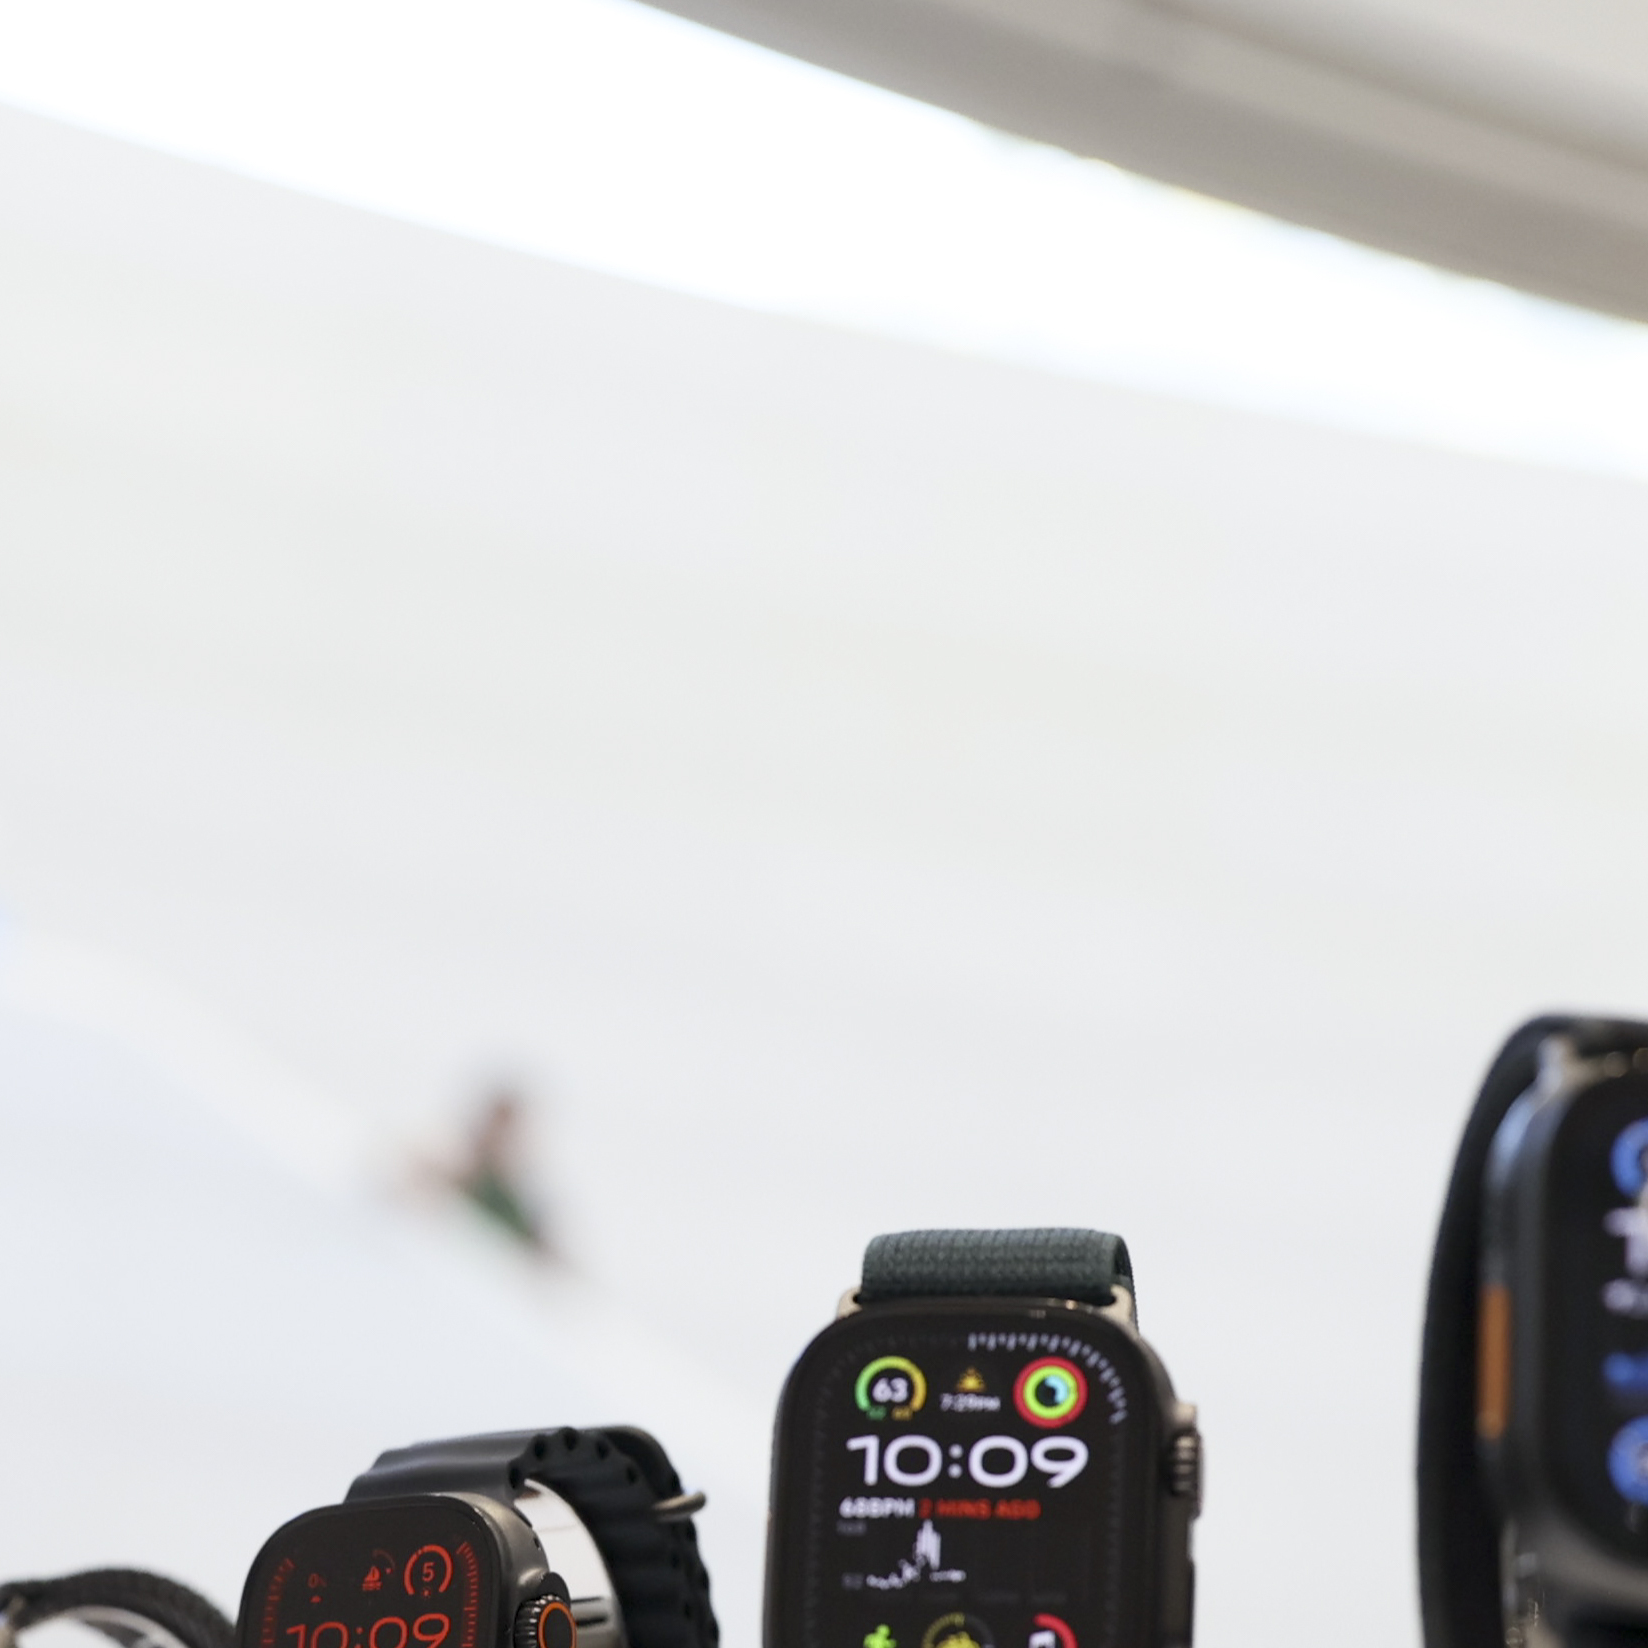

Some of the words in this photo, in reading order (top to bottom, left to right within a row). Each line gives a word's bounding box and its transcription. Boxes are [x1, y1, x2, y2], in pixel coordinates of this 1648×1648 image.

[872, 1377, 908, 1403] 63
[846, 1434, 1089, 1488] 10:09
[936, 1499, 992, 1519] MINS
[994, 1500, 1042, 1520] AGO
[421, 1561, 435, 1582] 5
